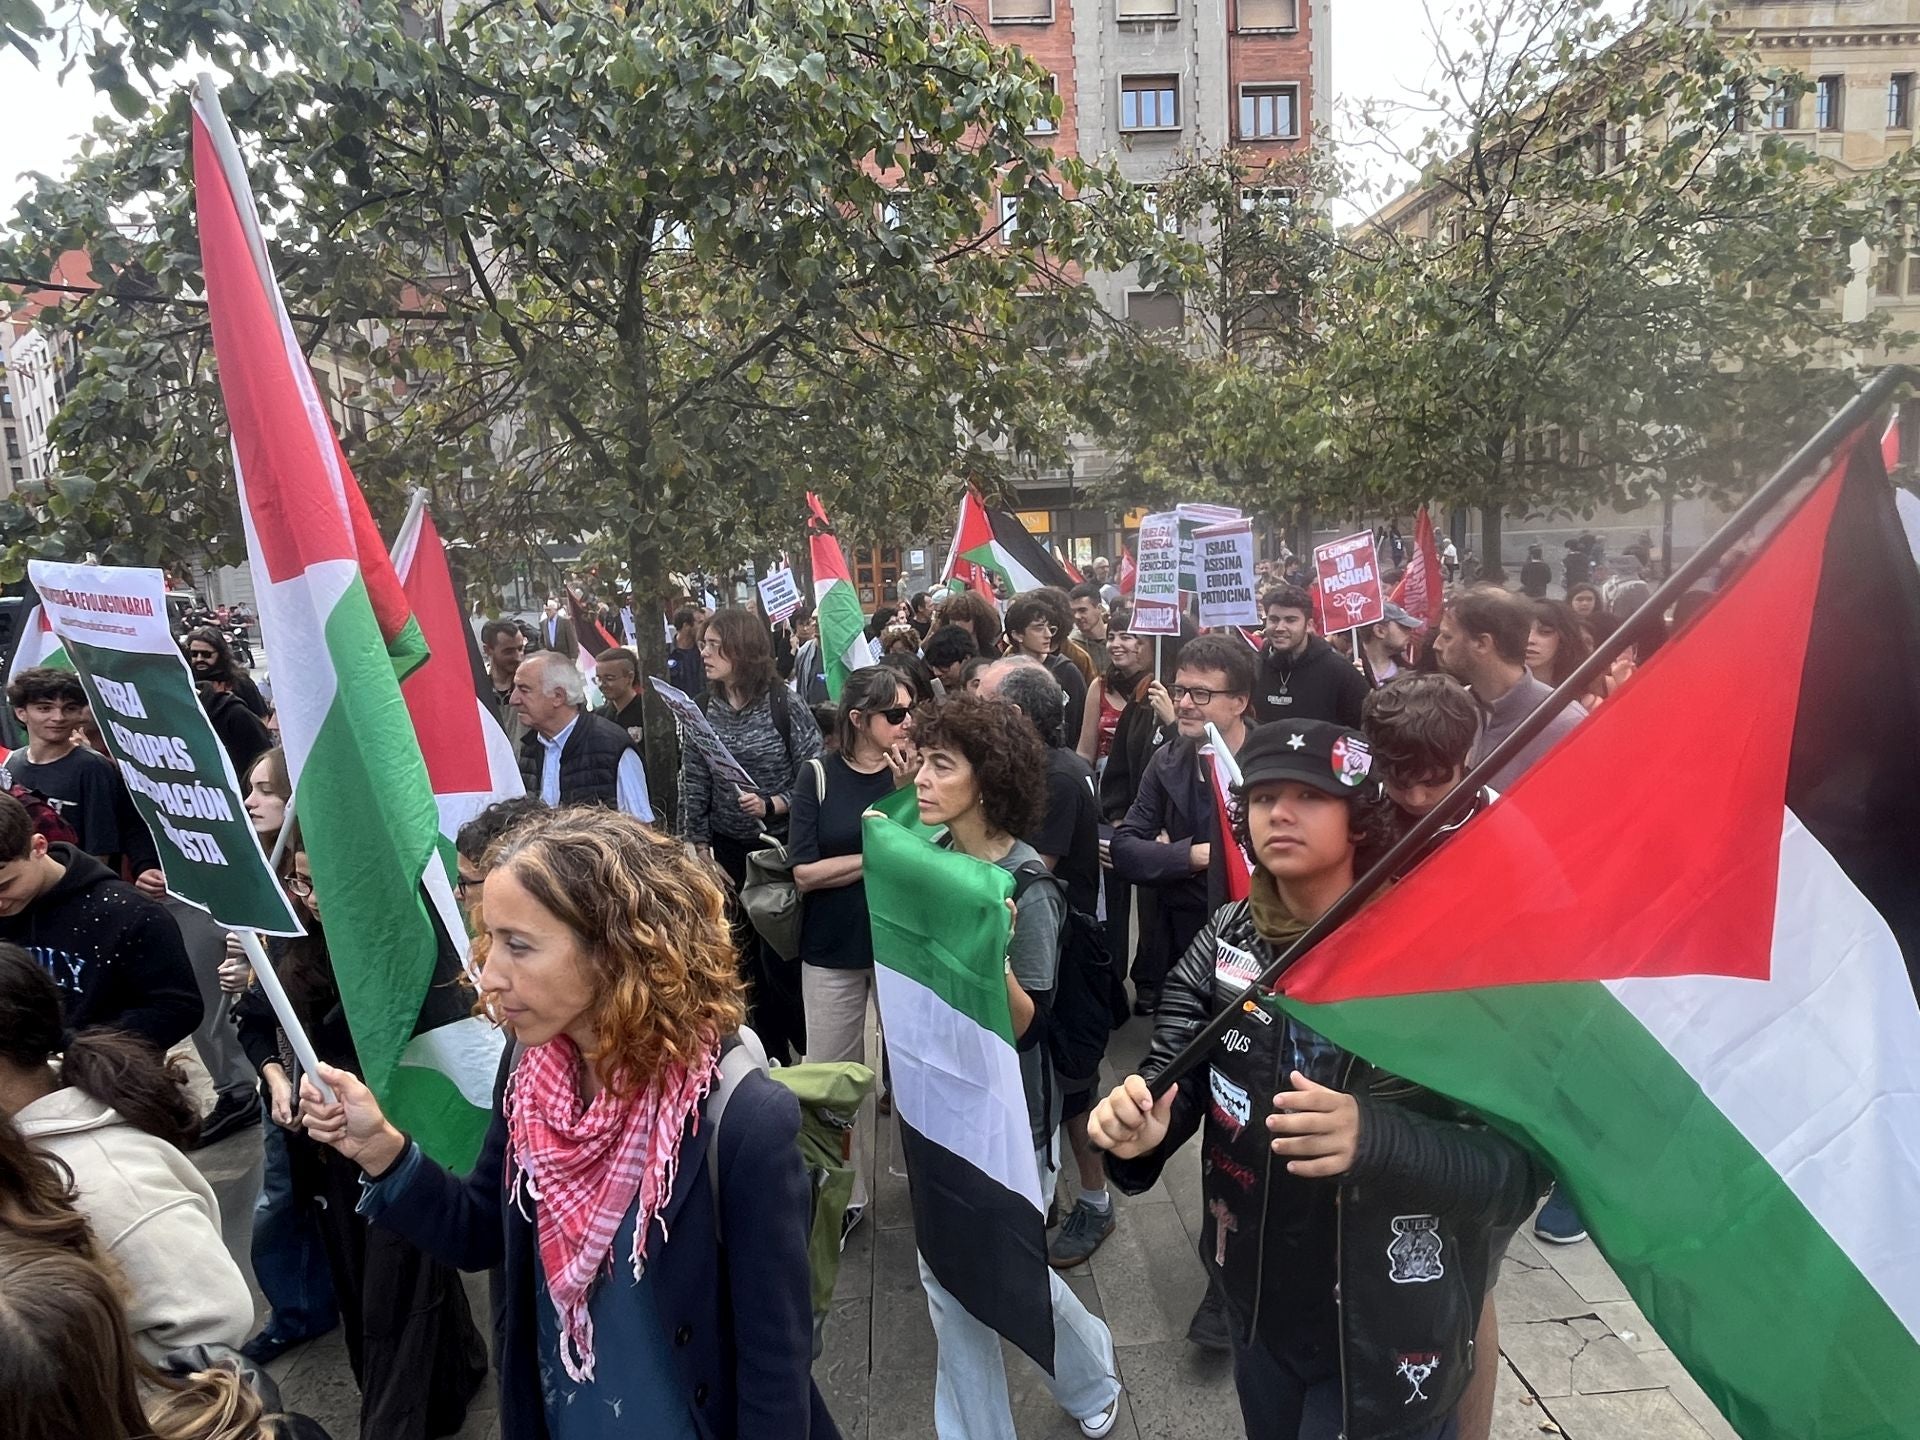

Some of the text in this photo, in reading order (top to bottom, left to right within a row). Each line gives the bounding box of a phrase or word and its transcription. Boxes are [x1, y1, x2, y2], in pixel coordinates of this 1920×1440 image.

[1141, 538, 1173, 551] GENERAL
[1206, 540, 1237, 556] ISRAEL
[1161, 551, 1169, 560] EL
[1204, 555, 1243, 572] ASESINA
[1336, 553, 1355, 573] NO
[1139, 560, 1177, 571] GENOCIDIO
[1207, 572, 1242, 588] EUROPA
[1324, 562, 1373, 593] PASARÁ
[1138, 585, 1175, 594] PALESTINO
[1201, 588, 1251, 604] PATROCINA
[1394, 1219, 1437, 1233] QUEEN
